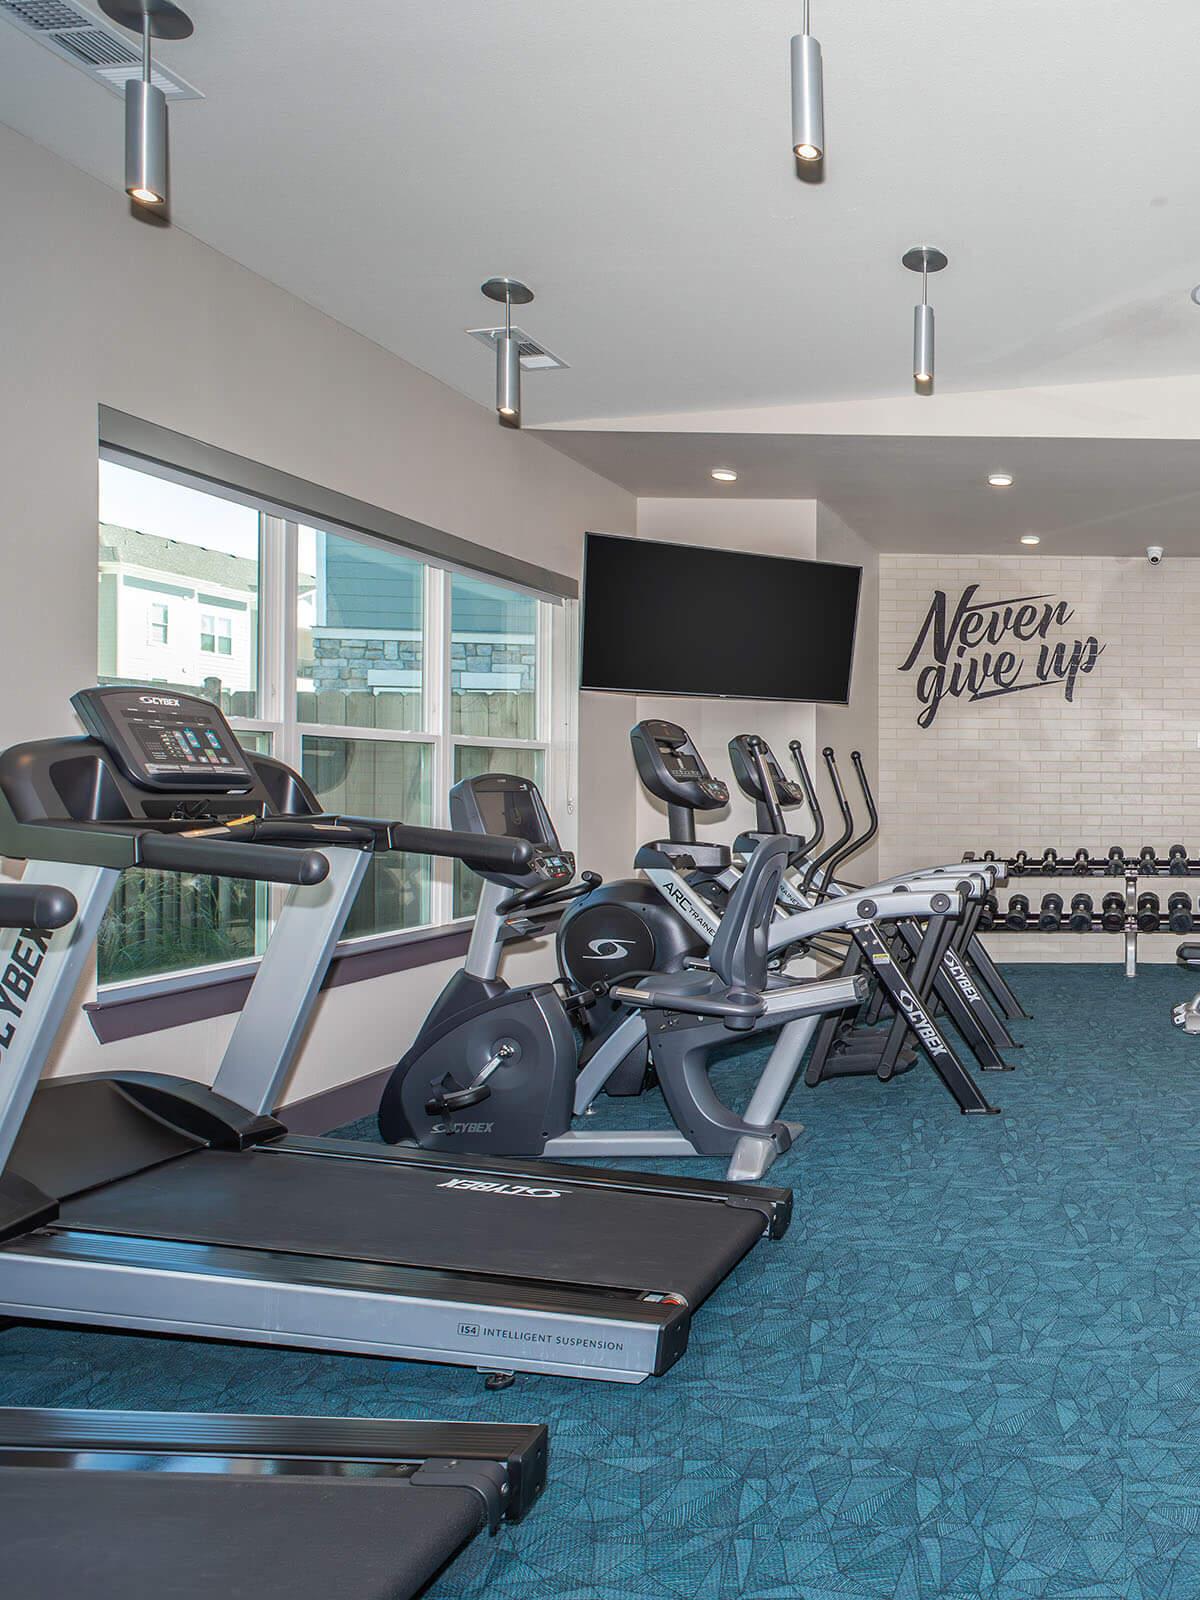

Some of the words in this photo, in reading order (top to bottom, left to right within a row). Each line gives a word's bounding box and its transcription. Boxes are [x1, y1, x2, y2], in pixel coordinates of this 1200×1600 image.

[897, 584, 1075, 671] Never
[916, 645, 1025, 729] give
[1036, 636, 1107, 702] up
[662, 882, 692, 912] ARC
[690, 906, 716, 937] TRAINE
[949, 964, 981, 1003] CYBEX
[909, 1010, 948, 1057] CYBEX
[451, 1121, 495, 1133] CYBEX
[436, 1178, 530, 1196] CYBEX
[460, 1325, 477, 1335] IS4
[483, 1327, 553, 1344] INTELLIGENT
[555, 1335, 624, 1351] SUSPENSION
